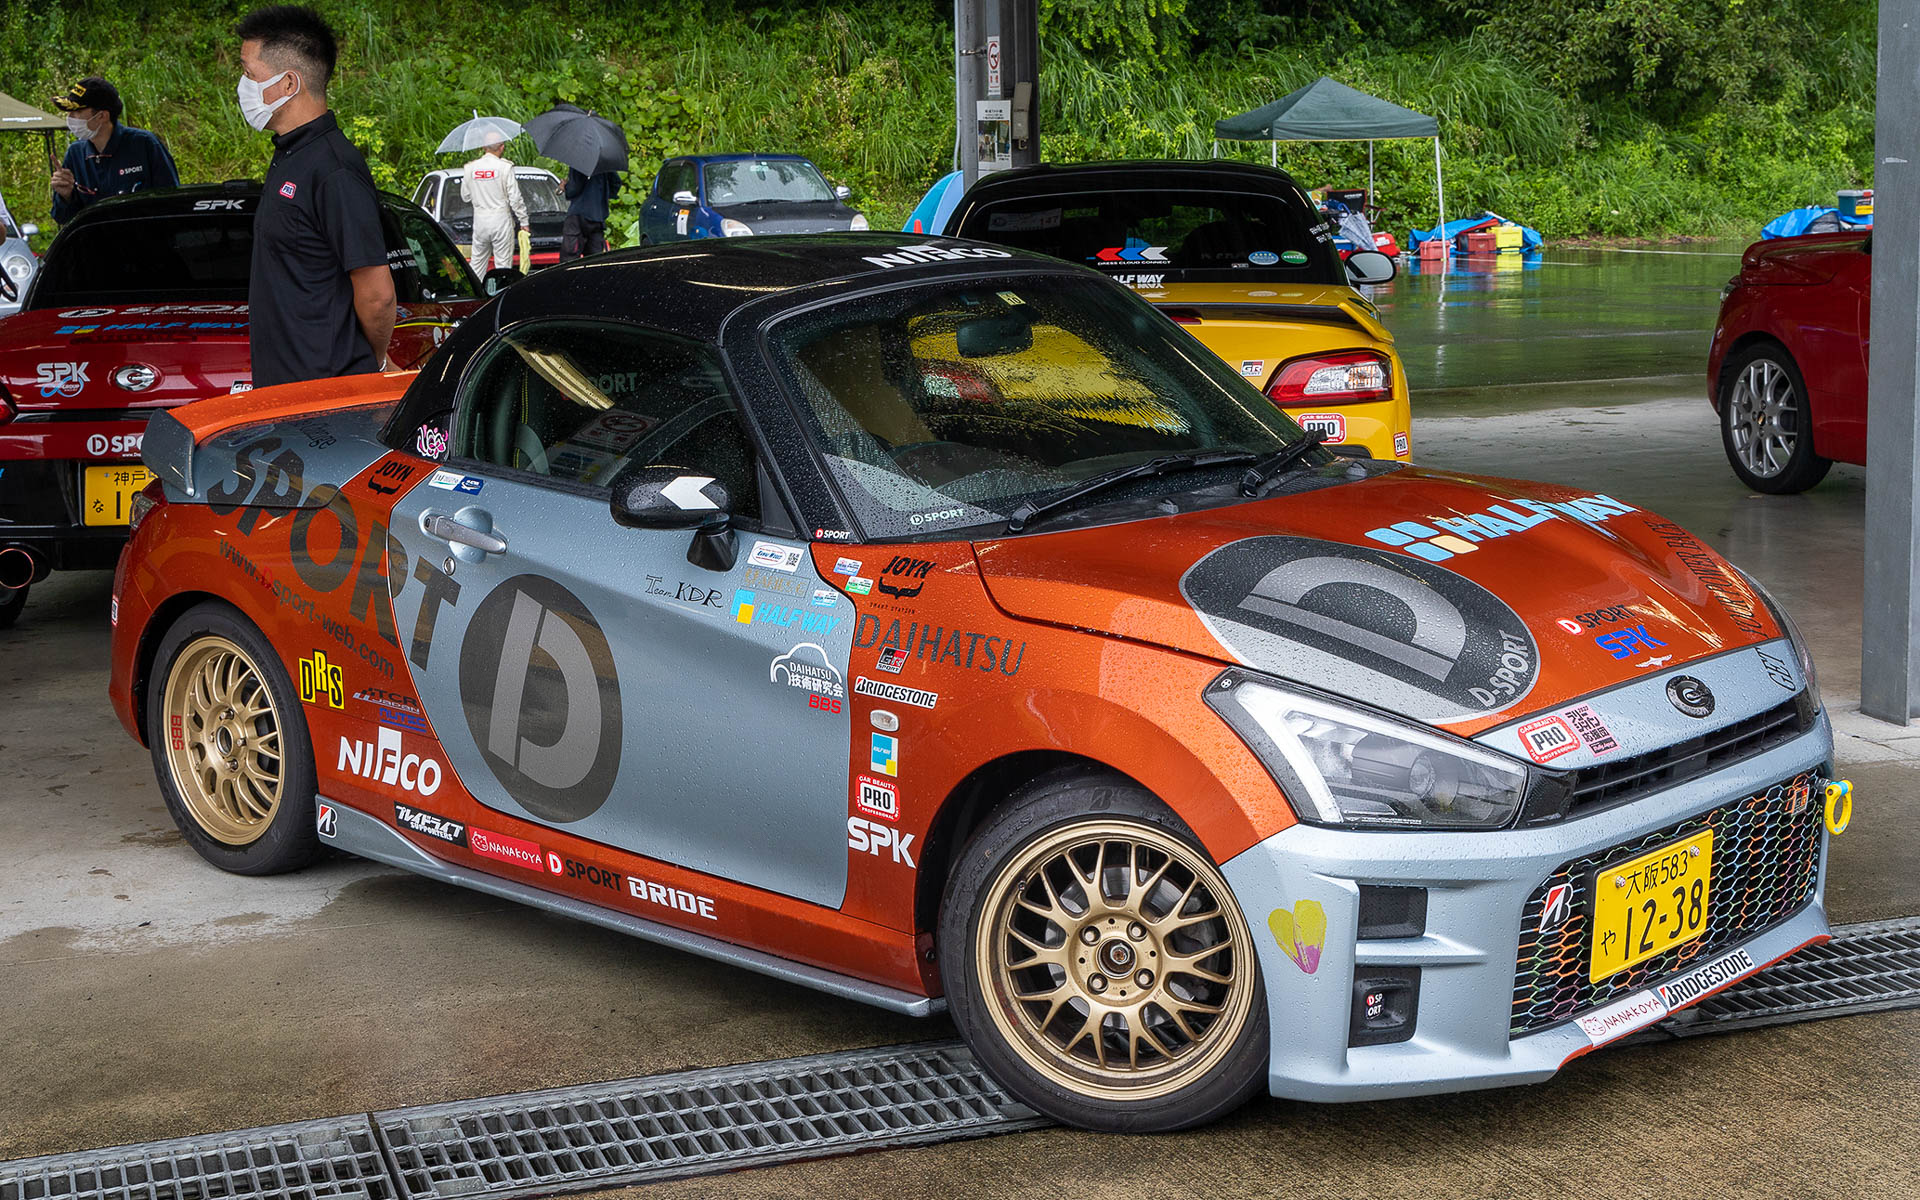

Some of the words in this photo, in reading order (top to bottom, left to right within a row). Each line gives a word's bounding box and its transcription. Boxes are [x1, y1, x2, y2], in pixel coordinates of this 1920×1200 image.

[193, 199, 246, 211] SPK
[862, 246, 1012, 268] NIFCO
[1110, 274, 1136, 284] ALF
[1137, 274, 1165, 284] WAY
[36, 362, 90, 383] SPK
[114, 471, 152, 486] 神戸
[376, 460, 415, 482] JOYN
[93, 499, 104, 513] な
[924, 508, 965, 524] SPORT
[1432, 499, 1557, 542] HALF
[824, 530, 850, 540] SPORT
[206, 437, 462, 672] SPORT
[882, 556, 937, 578] JOYN
[674, 582, 723, 608] KDR
[755, 602, 802, 628] HALF
[800, 612, 840, 635] WAY
[1576, 605, 1637, 629] SPORT
[854, 613, 1026, 677] DAIHATSU
[1595, 625, 1668, 660] SPK
[300, 649, 345, 709] DRS
[790, 662, 832, 680] DAIHATSU
[878, 664, 899, 672] SPORT
[1468, 630, 1529, 707] D-SPORT
[791, 674, 843, 698] 技術研究会
[856, 677, 936, 707] BRIDGESTONE
[808, 694, 842, 714] BBS
[171, 714, 184, 751] BBS
[1531, 726, 1566, 751] PRO
[337, 726, 441, 796] NIFCO
[872, 779, 895, 790] BEAUTY
[864, 787, 890, 809] PRO
[410, 822, 453, 841] SUPPORTERS
[848, 816, 916, 869] SPK
[489, 842, 542, 864] NANAKOYA
[566, 859, 621, 892] SPORT
[627, 876, 717, 920] BRIDE
[1601, 931, 1617, 957] や
[1624, 879, 1704, 961] 12-38
[1660, 951, 1755, 1007] BRIDGESTONE
[1367, 1004, 1382, 1016] ORT
[1605, 997, 1661, 1029] NANAKOYA
